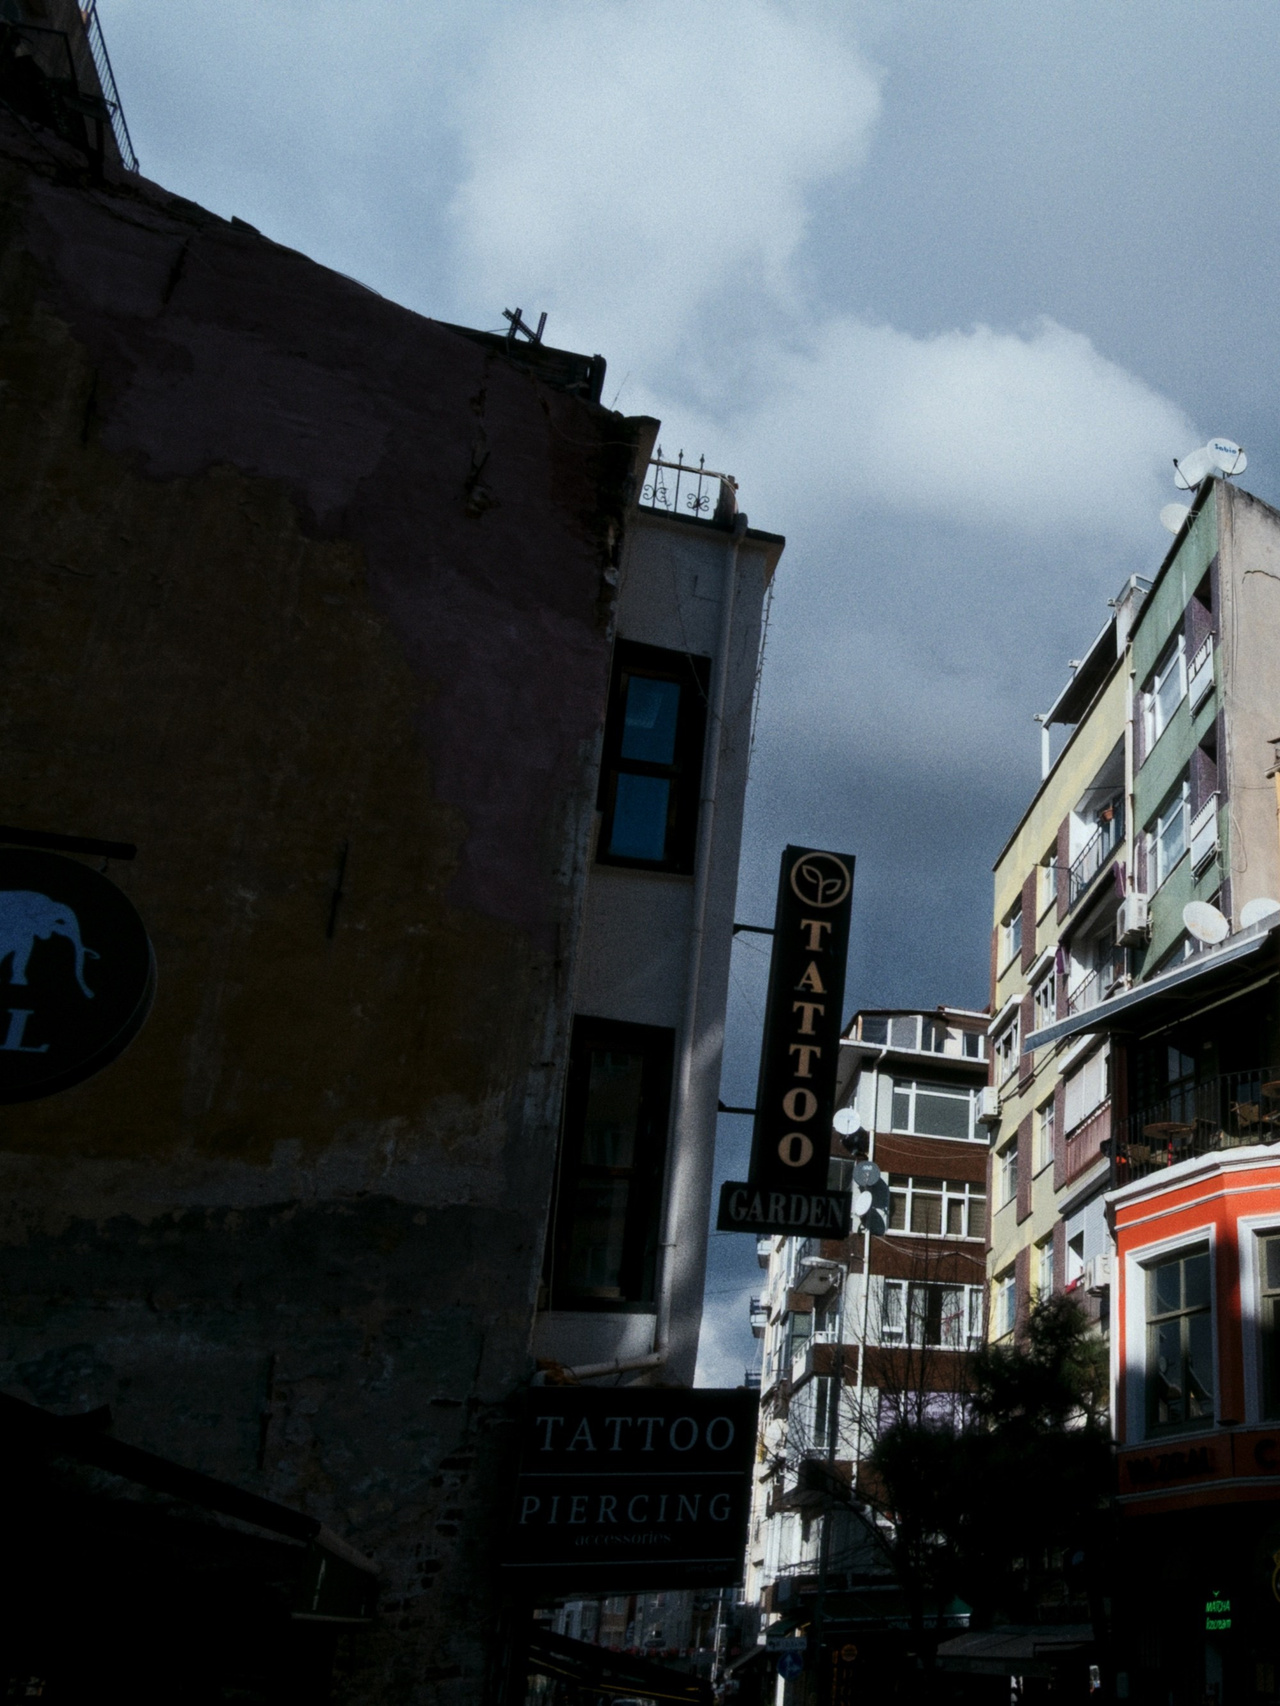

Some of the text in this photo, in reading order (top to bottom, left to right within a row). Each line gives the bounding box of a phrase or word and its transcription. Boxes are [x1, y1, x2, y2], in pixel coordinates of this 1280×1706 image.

[776, 917, 832, 1169] TATTOO
[727, 1188, 847, 1230] GARDEN
[534, 1415, 736, 1453] TATTOO
[517, 1492, 733, 1526] PIERCING
[573, 1531, 672, 1546] accessories
